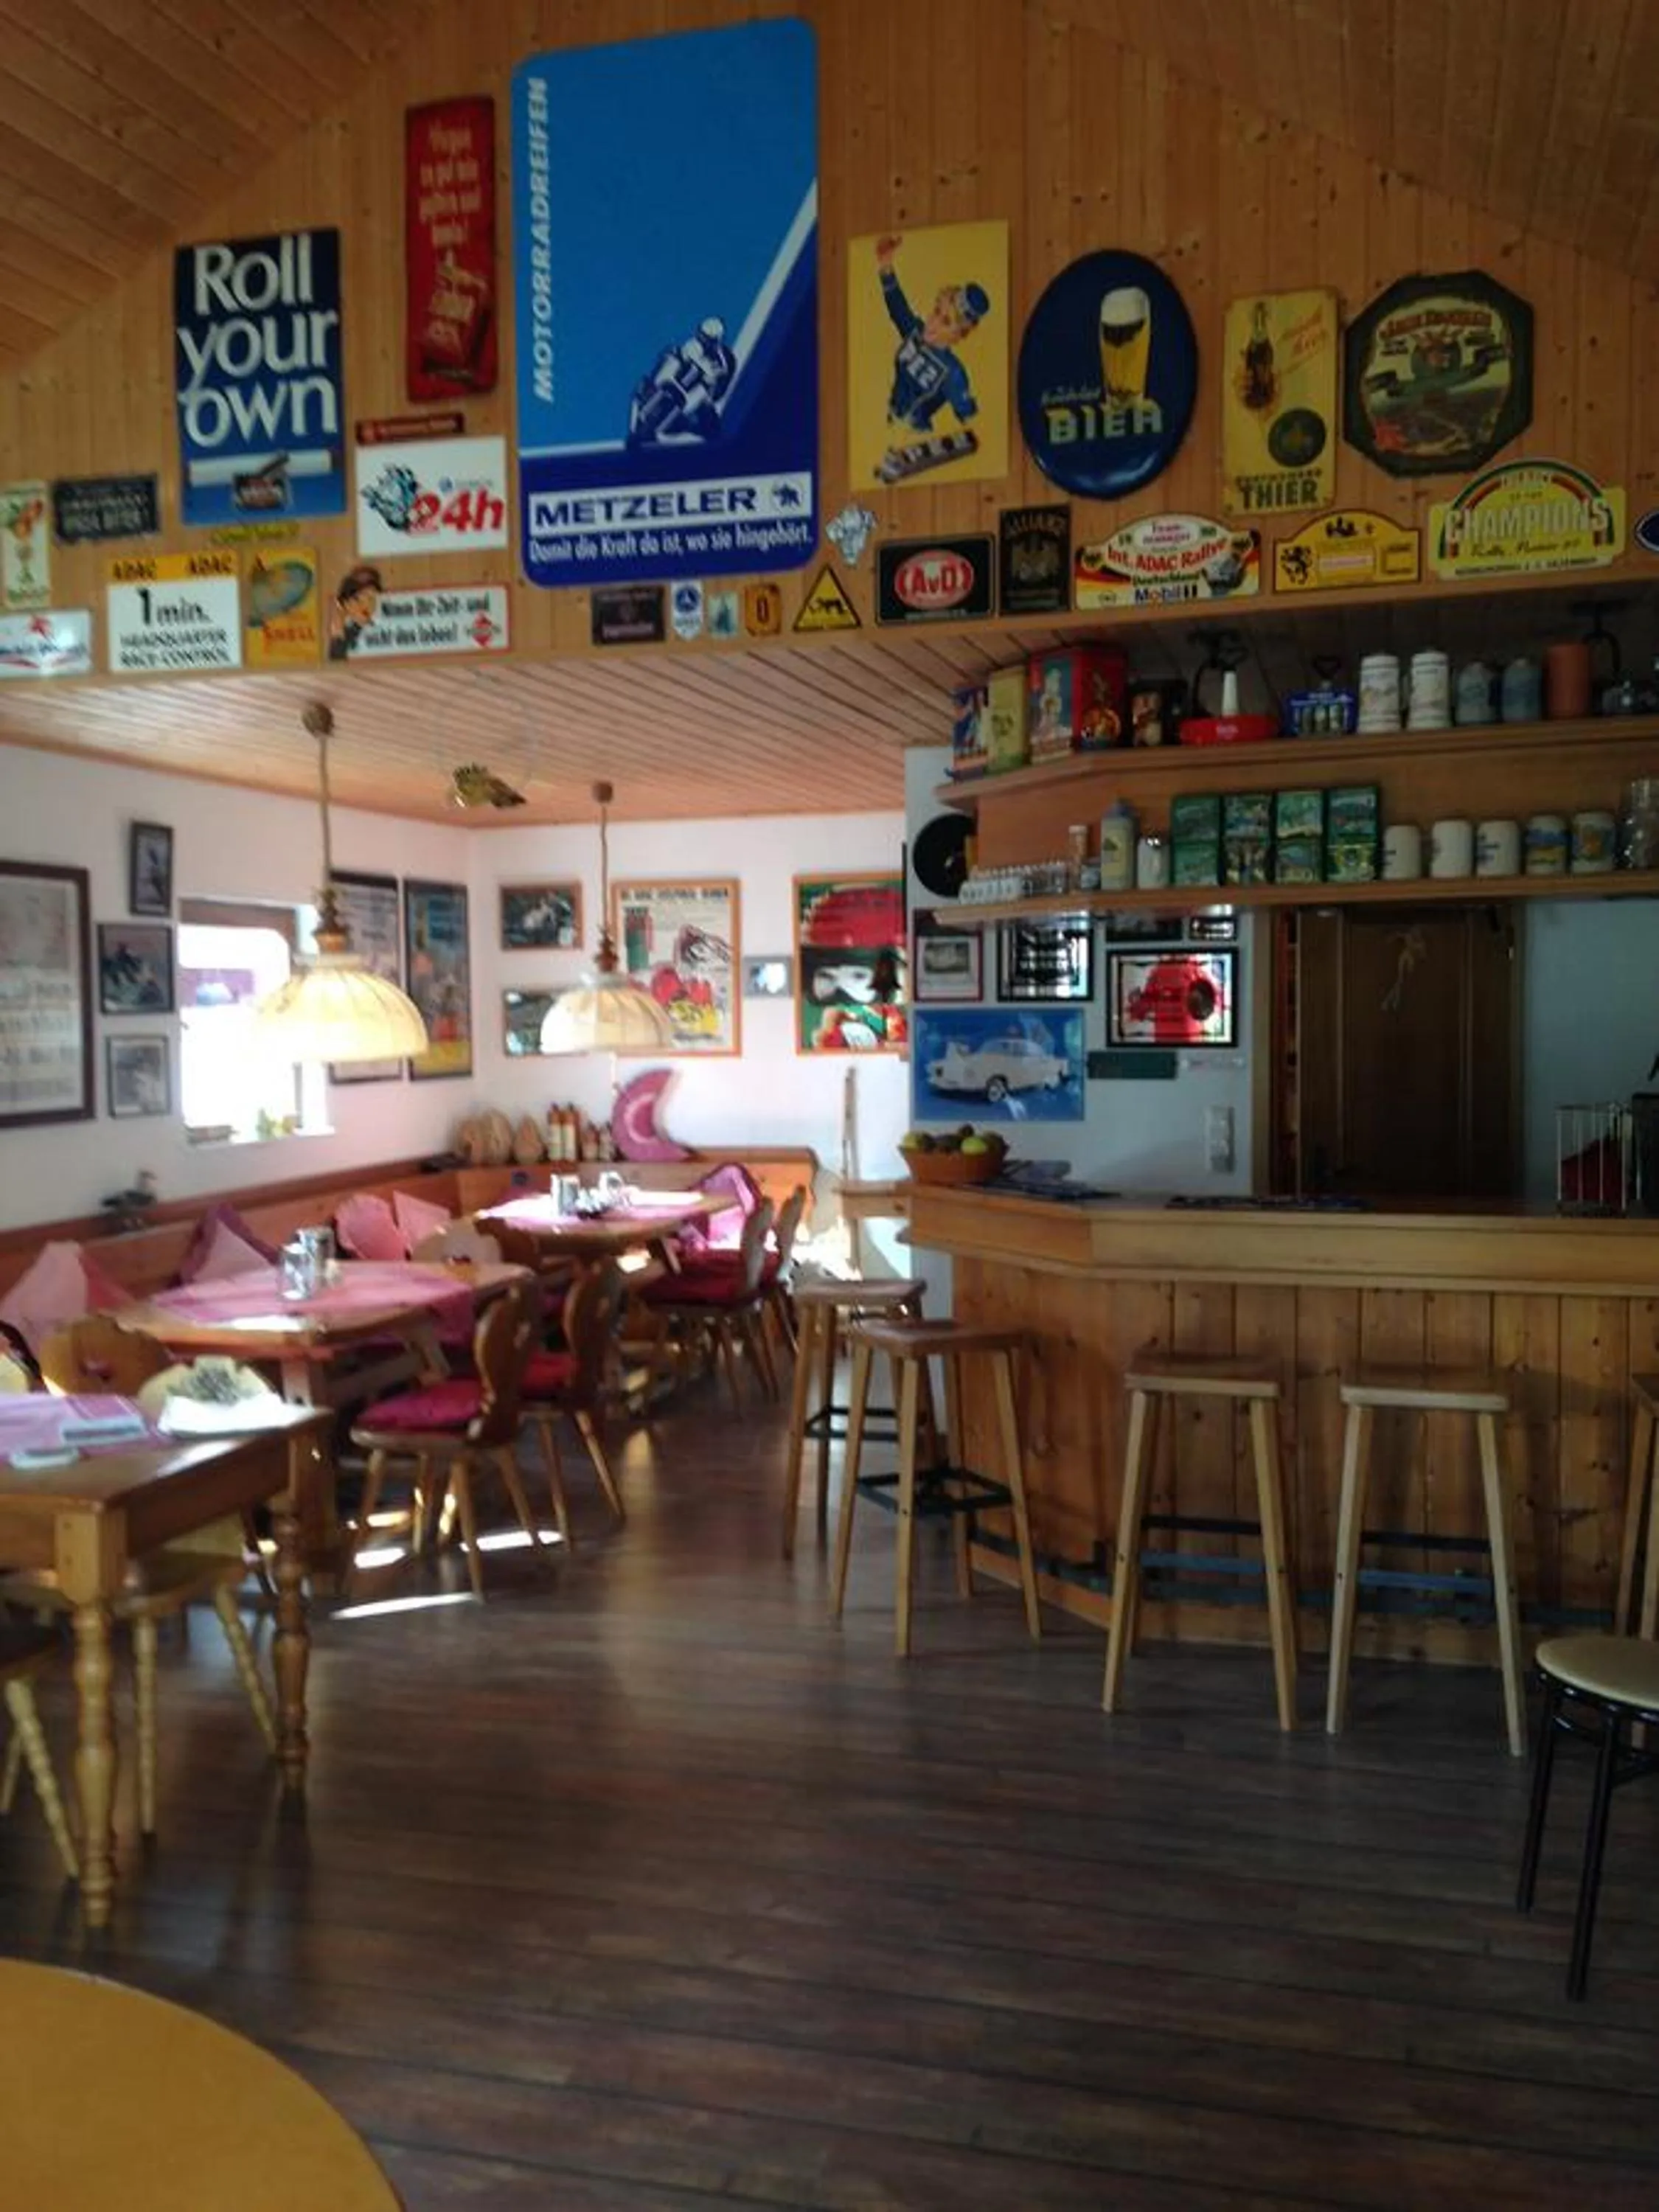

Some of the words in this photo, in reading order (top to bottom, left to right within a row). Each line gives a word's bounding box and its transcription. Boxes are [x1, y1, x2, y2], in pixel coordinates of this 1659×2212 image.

[528, 77, 554, 403] MOTORRADREIFEN
[194, 233, 313, 316] Roll
[177, 310, 337, 404] your
[184, 374, 337, 447] own
[1046, 399, 1162, 443] BIER
[410, 487, 504, 532] 24h
[535, 487, 757, 526] METZELER
[1239, 479, 1318, 510] THIER
[1444, 499, 1608, 544] CHAMPIONS
[530, 536, 571, 563] Damit
[576, 534, 598, 560] die
[602, 532, 636, 557] Kraft
[641, 532, 660, 554] da
[663, 529, 684, 556] ist,
[686, 532, 708, 552] wo
[712, 525, 732, 550] sie
[1107, 543, 1132, 566] Int.
[1135, 555, 1178, 572] ADAC
[1180, 538, 1228, 568] Rallye
[113, 560, 157, 581] ADAC
[188, 554, 233, 575] ADAC
[1133, 571, 1200, 587] Deutschland
[137, 588, 150, 626] 1
[156, 597, 212, 627] min.
[1135, 586, 1183, 602] Mobil
